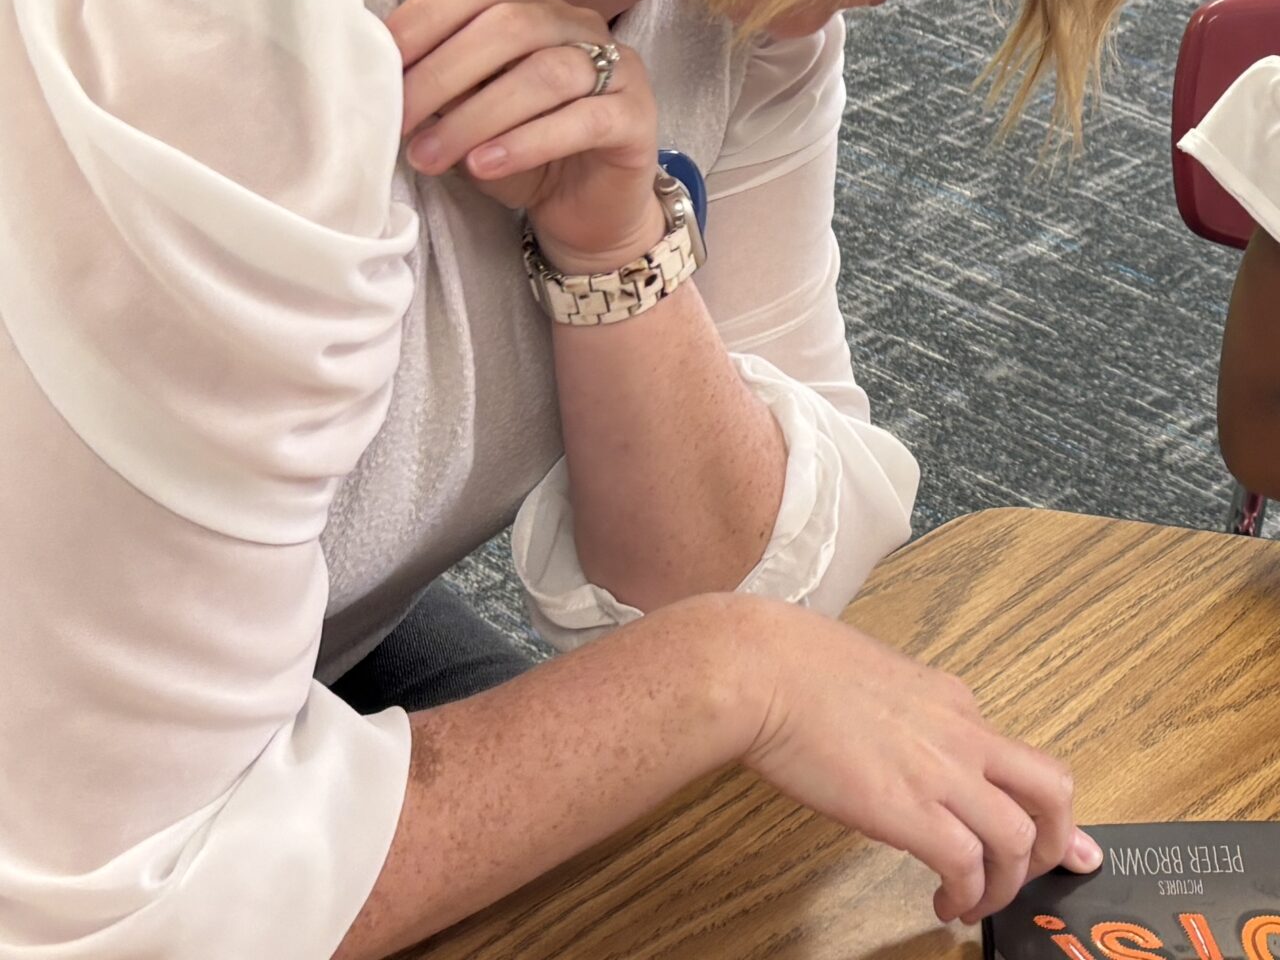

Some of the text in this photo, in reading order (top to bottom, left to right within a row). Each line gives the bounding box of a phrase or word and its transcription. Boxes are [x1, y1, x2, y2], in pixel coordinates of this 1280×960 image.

[1109, 844, 1245, 876] PETER BROWN
[1158, 879, 1204, 896] PICTURES
